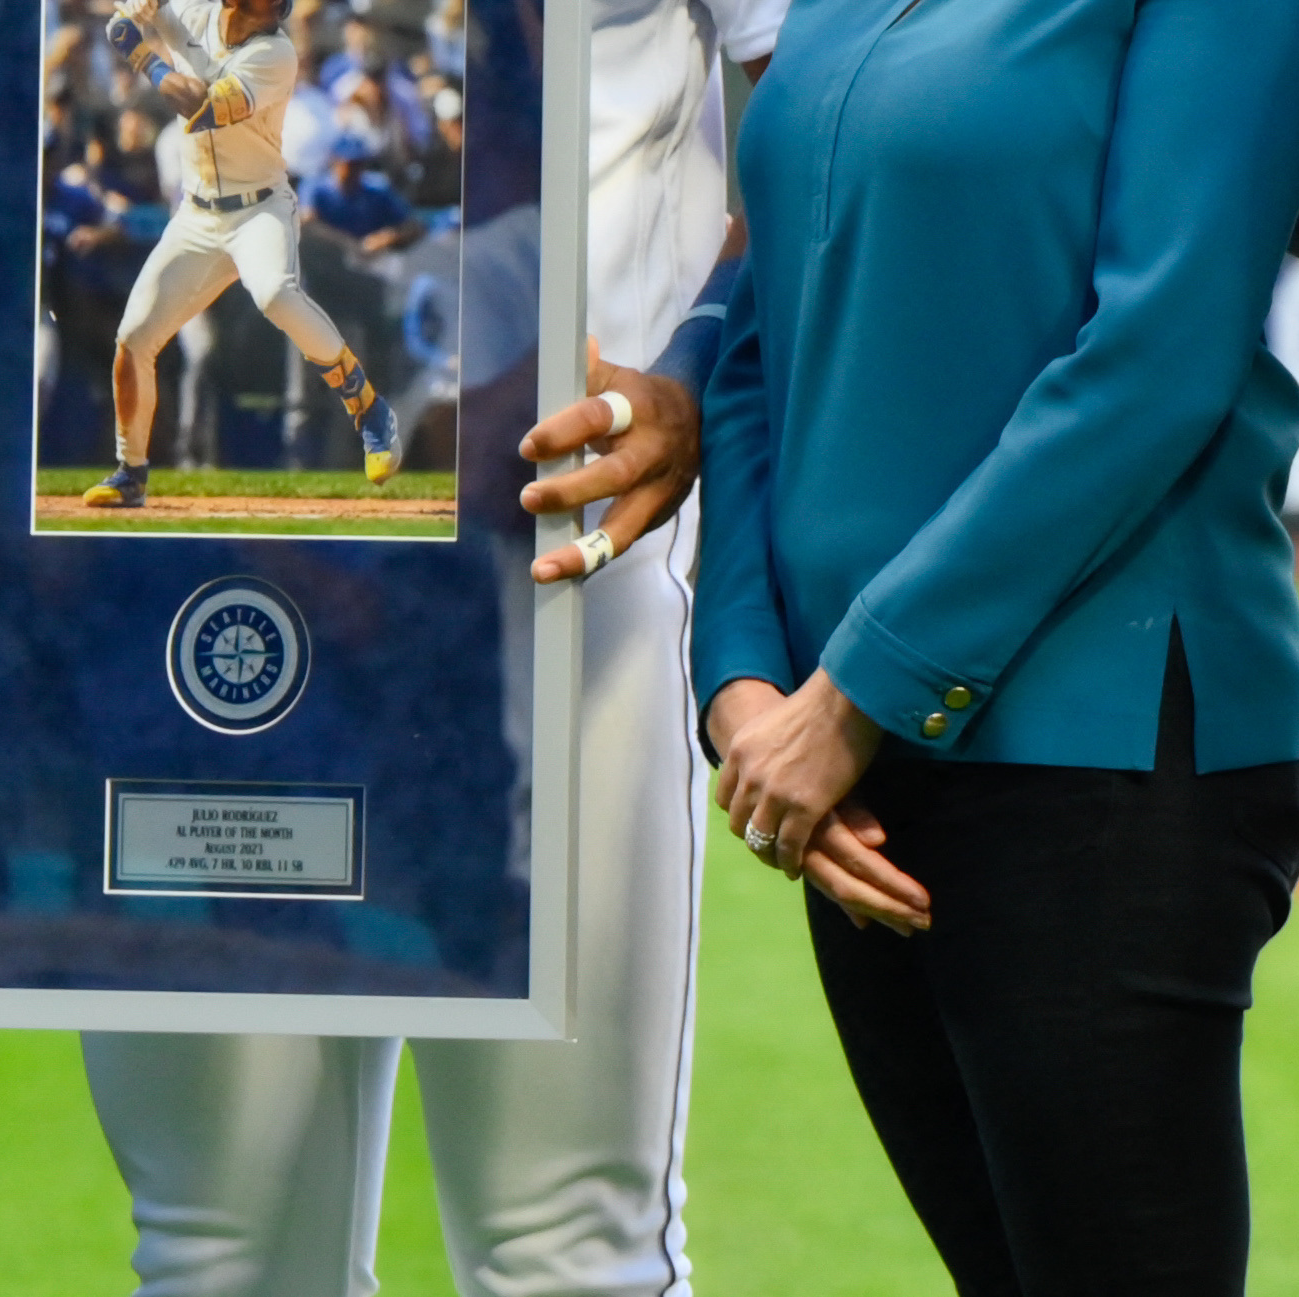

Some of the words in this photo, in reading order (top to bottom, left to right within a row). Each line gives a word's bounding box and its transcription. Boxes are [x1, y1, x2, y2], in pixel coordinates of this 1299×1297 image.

[200, 608, 278, 644] SEATTLE
[200, 663, 279, 701] MARINERS
[192, 808, 219, 823] JULIO
[189, 826, 222, 838] PLAYER
[224, 826, 237, 839] OF
[241, 826, 257, 839] THE
[261, 827, 293, 840] MONTH
[212, 857, 218, 870] 7
